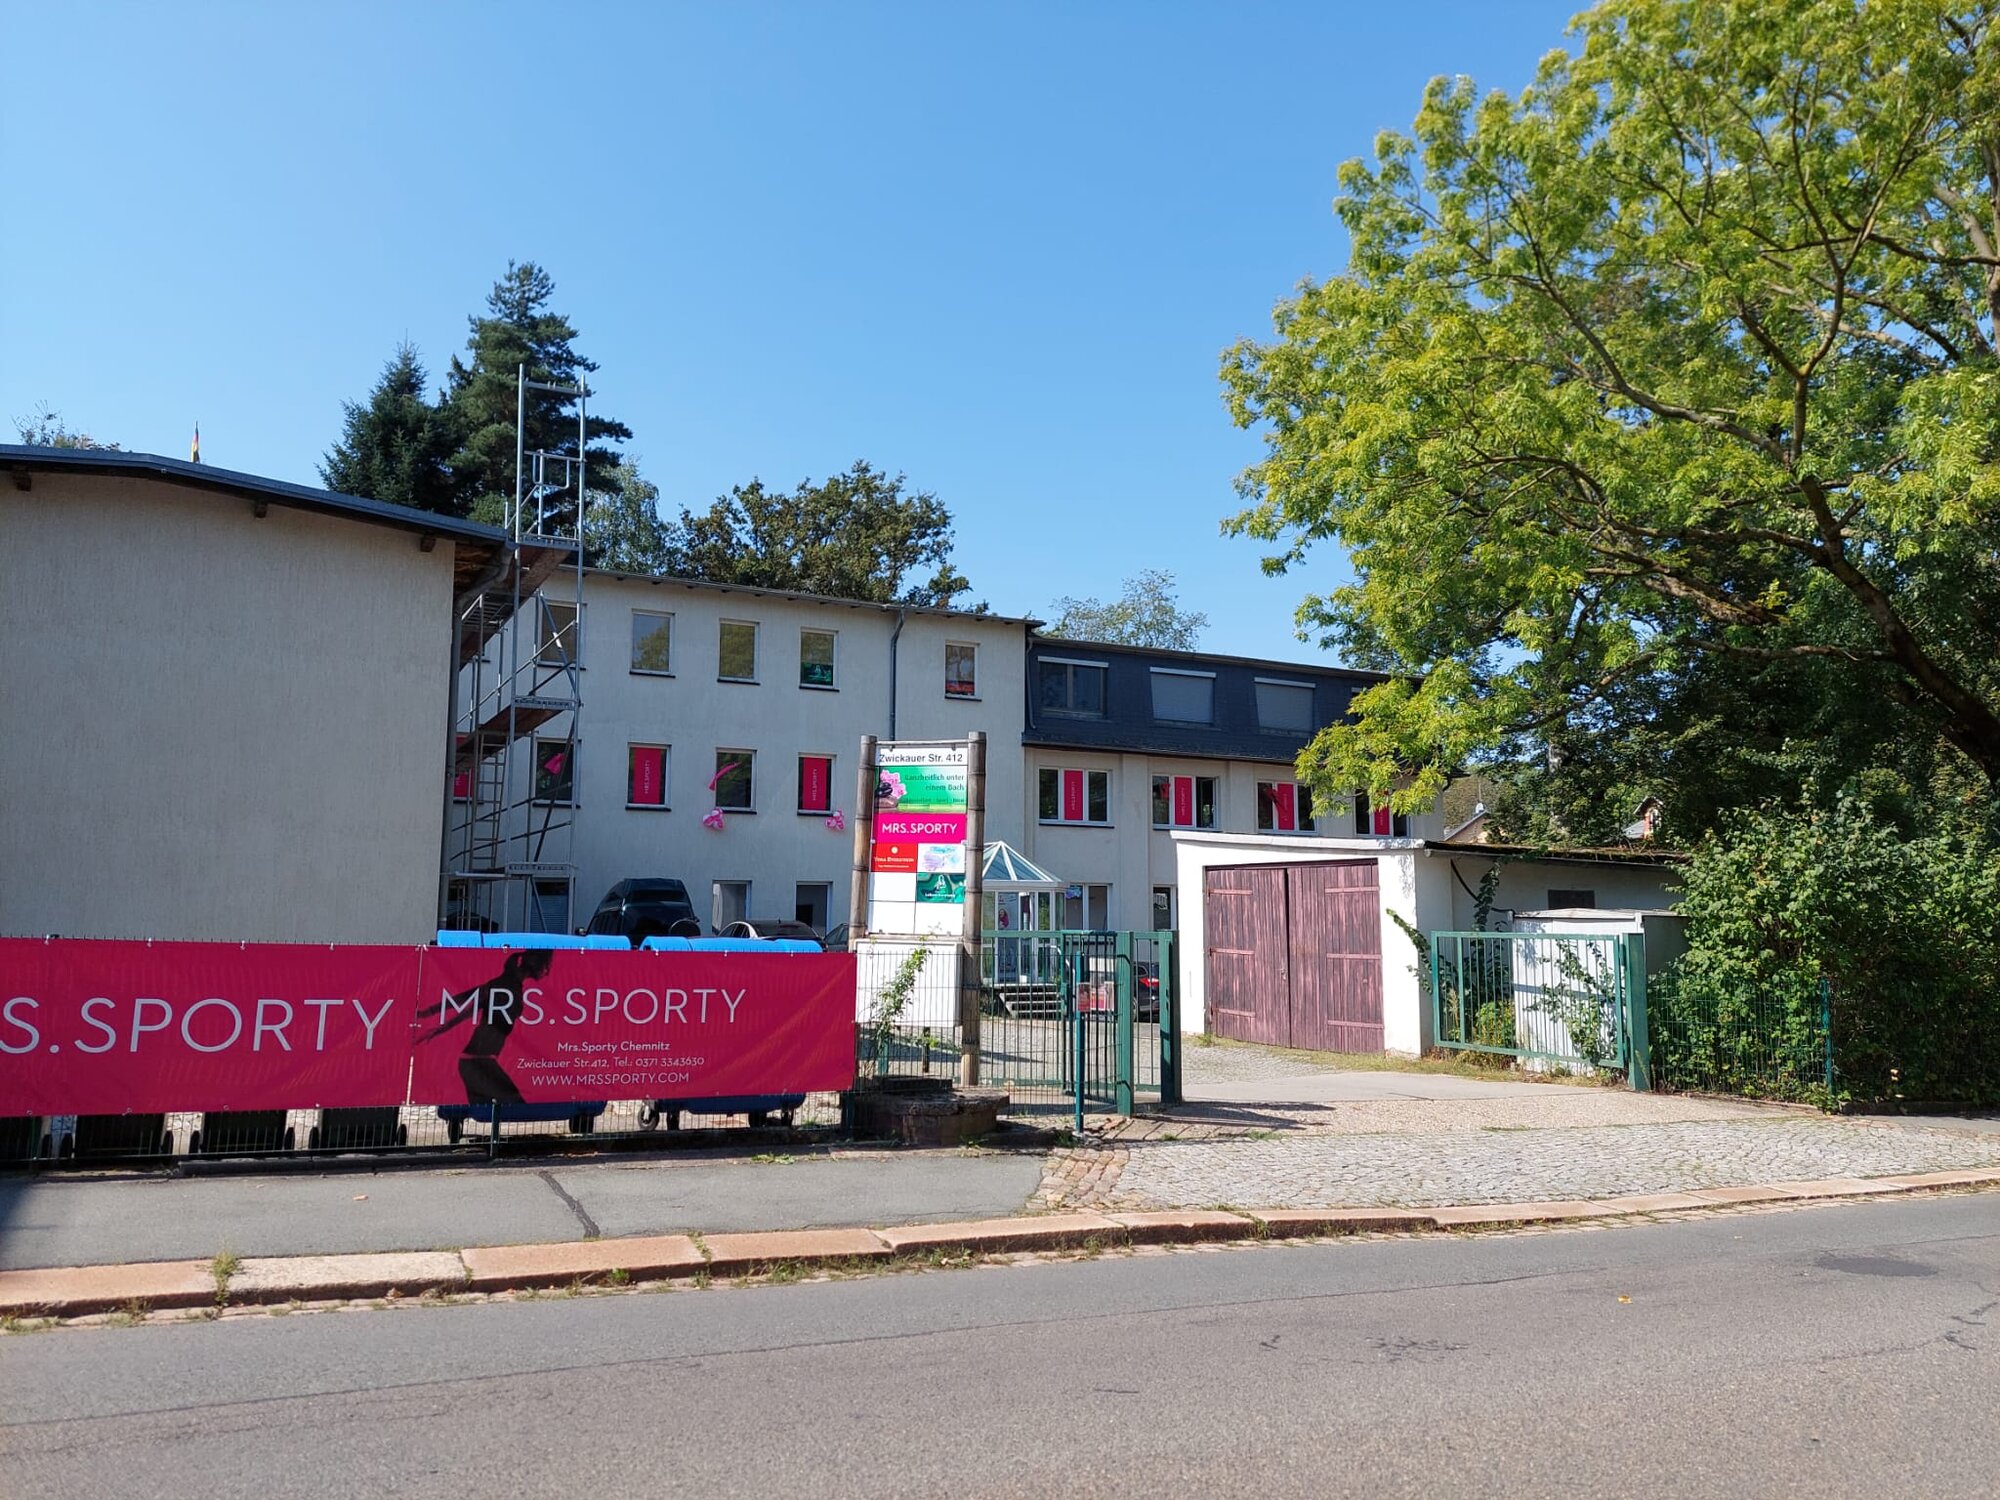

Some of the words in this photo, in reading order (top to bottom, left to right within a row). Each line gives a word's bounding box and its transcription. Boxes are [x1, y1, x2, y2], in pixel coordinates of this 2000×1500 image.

[880, 753, 925, 763] Zwickauer
[928, 753, 943, 763] Str.
[945, 753, 963, 763] 412
[881, 822, 957, 834] MRS.SPORTY
[439, 986, 746, 1026] MRS.SPORTY
[557, 1041, 617, 1054] Mrs.Sporty
[620, 1041, 670, 1052] Chemnitz
[517, 1058, 571, 1069] Zwickauer
[613, 1056, 633, 1067] Tel.:
[635, 1057, 658, 1068] 0371
[660, 1056, 705, 1067] 3343630
[531, 1072, 690, 1087] WWW.MRSSPORTY.COM
